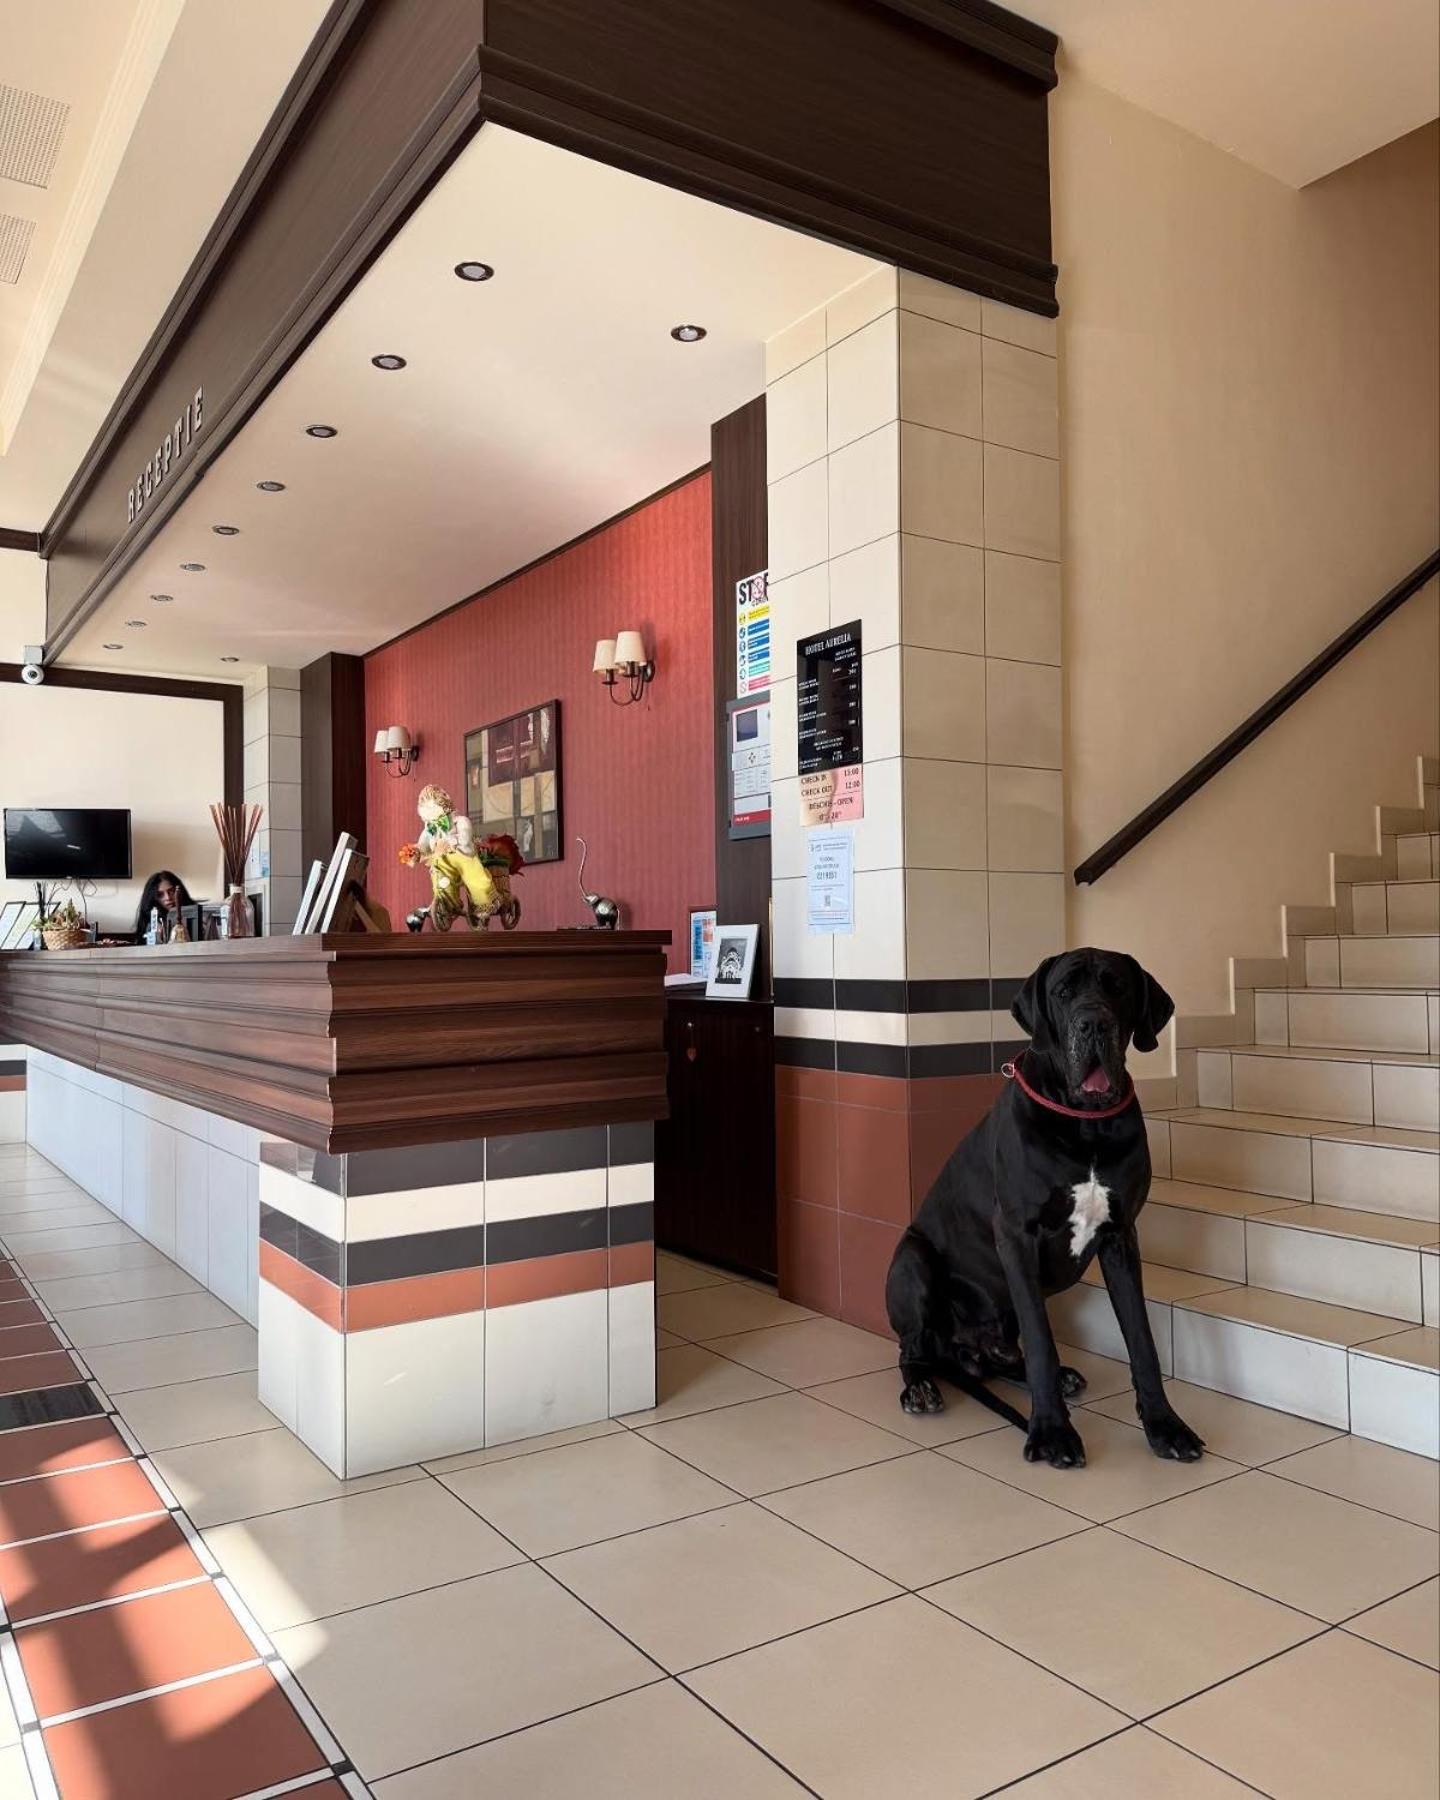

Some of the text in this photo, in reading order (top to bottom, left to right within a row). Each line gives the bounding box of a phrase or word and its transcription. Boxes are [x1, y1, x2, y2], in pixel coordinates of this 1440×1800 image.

[127, 386, 203, 524] RECEPTIE
[805, 641, 824, 656] HOTEL
[825, 633, 851, 648] AURELIA
[801, 775, 819, 784] CHECK
[801, 787, 820, 796] CHECK
[822, 785, 832, 793] OUT
[837, 797, 853, 805] OPEN
